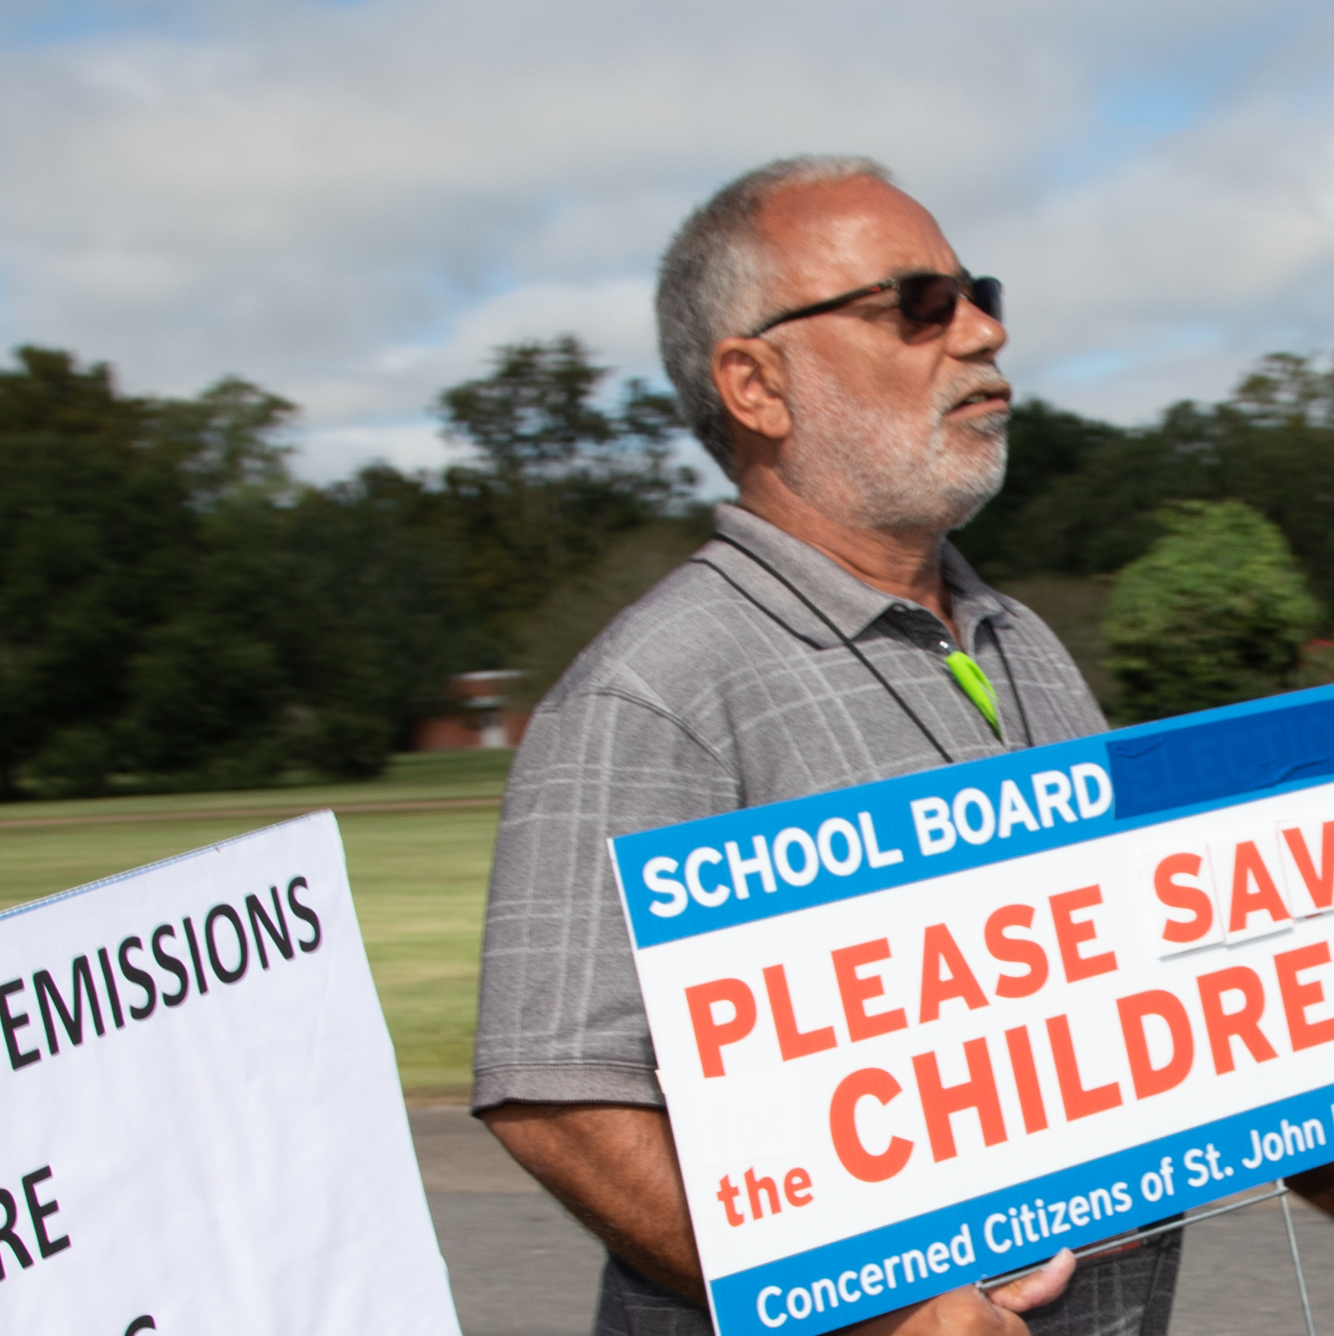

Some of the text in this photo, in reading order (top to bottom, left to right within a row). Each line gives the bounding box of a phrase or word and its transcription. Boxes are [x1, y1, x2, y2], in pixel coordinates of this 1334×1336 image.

[642, 811, 904, 918] SCHOOL
[909, 762, 1114, 857] BOARD
[684, 884, 1119, 1079] PLEASE
[716, 1167, 814, 1228] the
[756, 1223, 976, 1329] Concerned
[983, 1181, 1133, 1254] Citizens
[1140, 1156, 1175, 1202] of
[1183, 1143, 1234, 1188] St.
[1241, 1118, 1327, 1169] John
